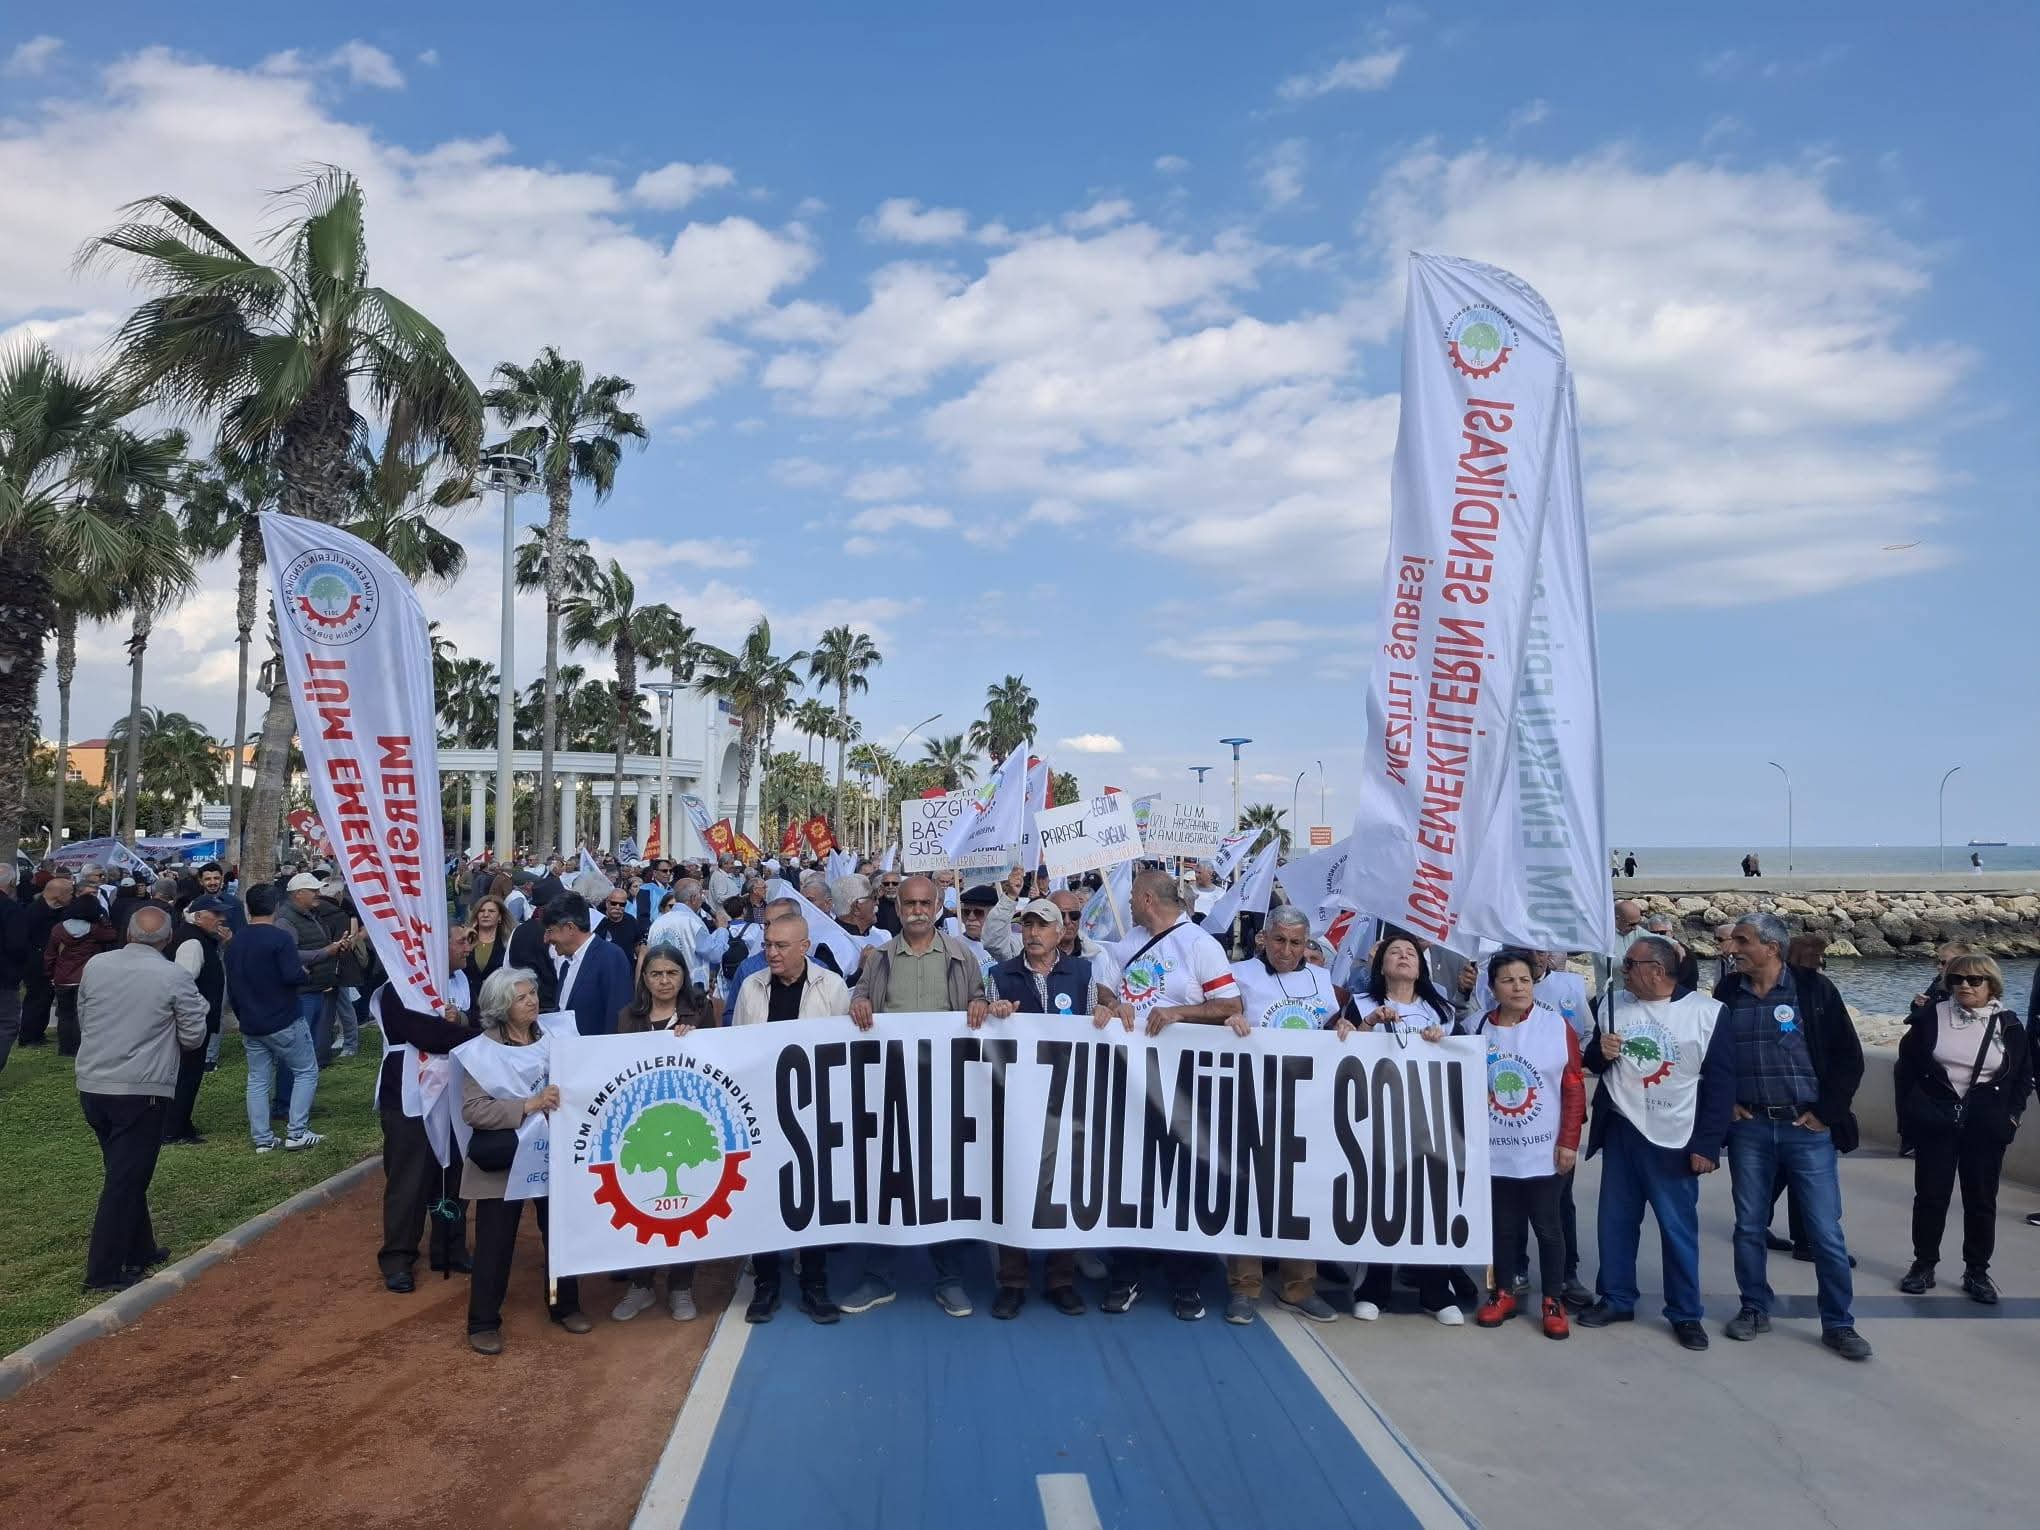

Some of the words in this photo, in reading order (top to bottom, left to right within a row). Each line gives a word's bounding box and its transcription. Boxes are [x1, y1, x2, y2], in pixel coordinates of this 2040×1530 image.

[574, 1122, 592, 1164] TÜM
[587, 1053, 697, 1117] EMEKLİLERİN
[702, 1063, 762, 1146] SENDİKASI
[1521, 1131, 1552, 1147] ŞUBESİ
[775, 1037, 1018, 1232] SEFALET
[1031, 1040, 1314, 1241] ZULMÜNE
[1332, 1055, 1468, 1249] SON!
[654, 1196, 689, 1212] 2017
